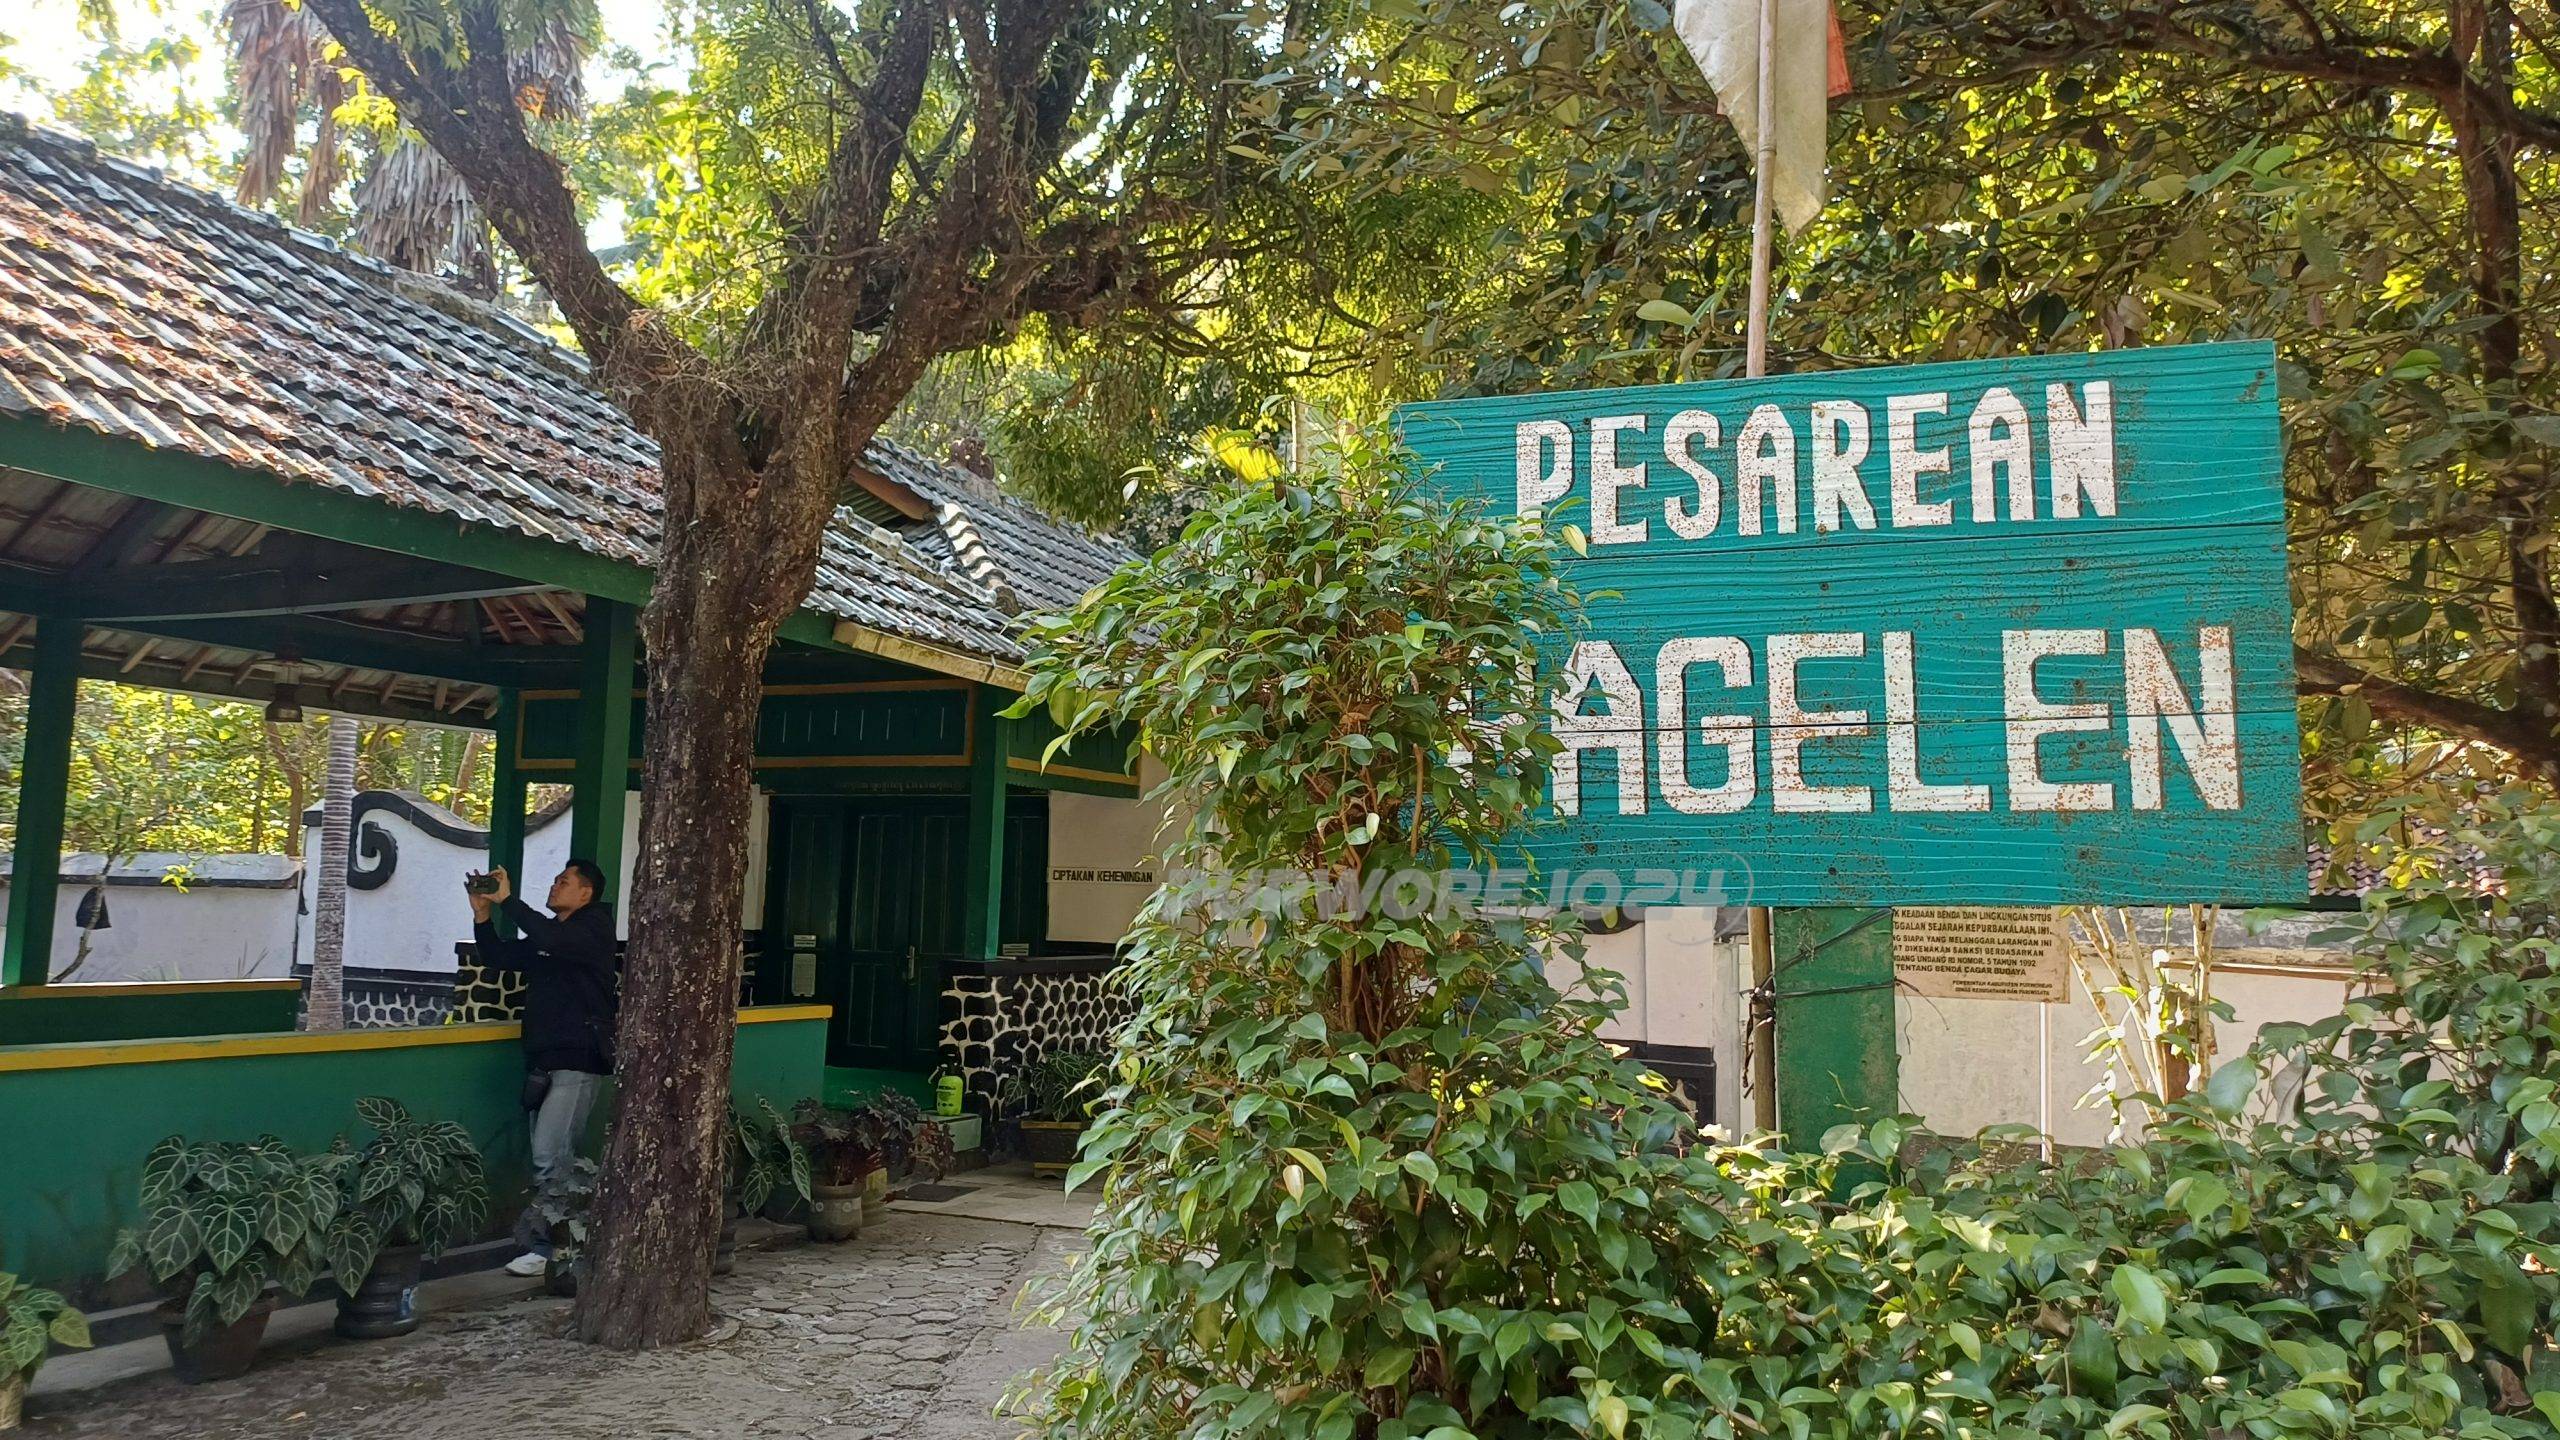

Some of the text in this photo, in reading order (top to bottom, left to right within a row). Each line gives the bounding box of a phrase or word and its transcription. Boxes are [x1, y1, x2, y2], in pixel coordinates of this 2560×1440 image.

[1516, 380, 2118, 545] PESAREAN
[1053, 869, 1153, 883] CIPTAKAN KEHENINGAN
[1901, 909, 1936, 919] KEADAAN
[1937, 910, 1961, 919] BENDA
[1962, 911, 1978, 920] DAN
[1979, 912, 2028, 922] LINGKUNGAN
[2029, 913, 2052, 922] SITUS
[1928, 922, 1964, 932] SEJARAH
[1903, 934, 1924, 942] SIAPA
[1926, 935, 1946, 944] YANG
[1948, 936, 1996, 945] MELANGGAR
[1997, 938, 2039, 947] LARANGAN
[2040, 939, 2052, 947] INI
[1905, 945, 1951, 954] DIKENAKAN
[1953, 946, 1983, 955] SANKSI
[1985, 947, 2044, 957] BERDASARKAN
[1917, 955, 1947, 964] UNDANG
[1986, 957, 1992, 965] 5
[1993, 958, 2018, 967] TAHUN
[2019, 959, 2036, 968] 1992
[1895, 963, 2027, 976] TENTANG BENDA CAGAR BUDAYA
